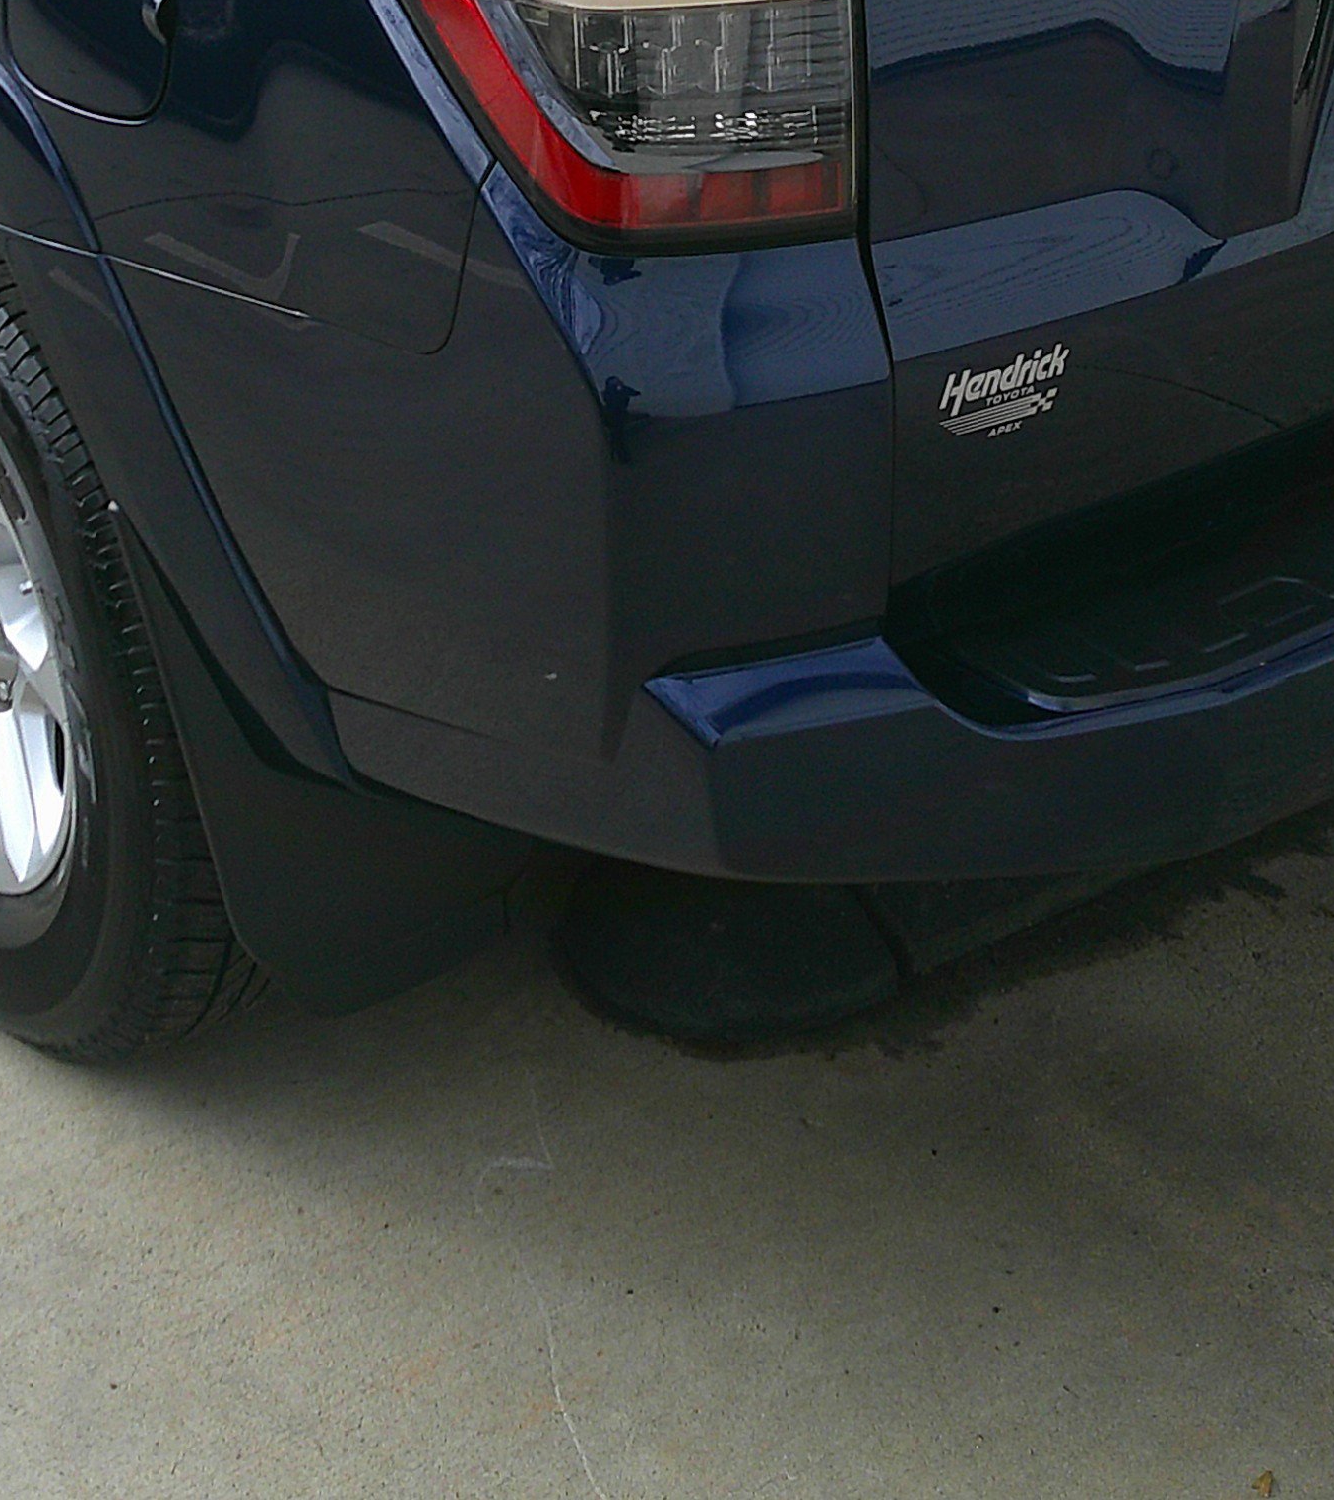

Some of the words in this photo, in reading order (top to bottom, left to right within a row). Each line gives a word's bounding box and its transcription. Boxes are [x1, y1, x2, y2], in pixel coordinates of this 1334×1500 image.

[939, 343, 1070, 417] Hendrick
[985, 385, 1036, 407] TOYOTA
[987, 420, 1023, 438] APEX
